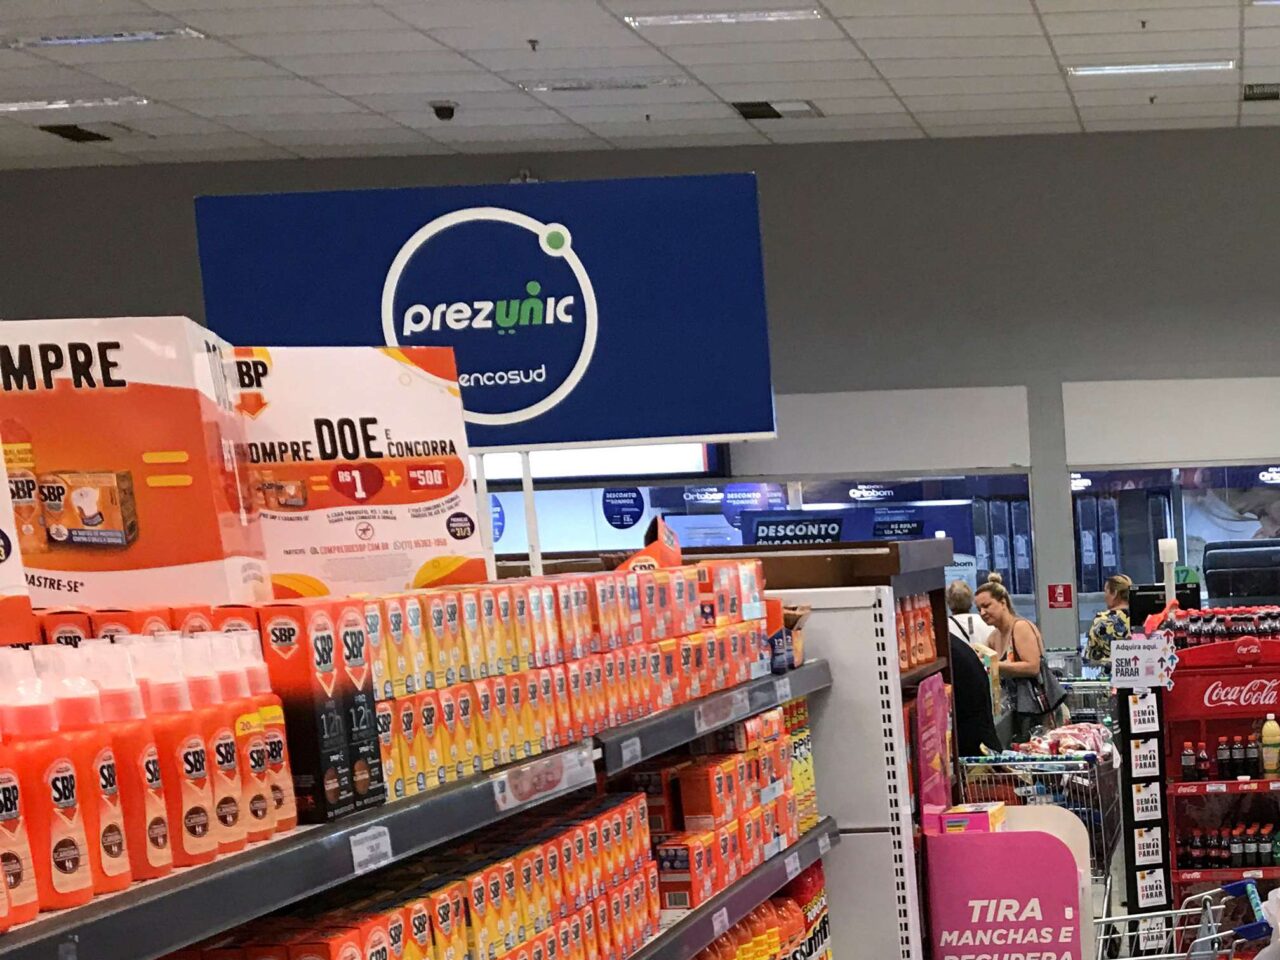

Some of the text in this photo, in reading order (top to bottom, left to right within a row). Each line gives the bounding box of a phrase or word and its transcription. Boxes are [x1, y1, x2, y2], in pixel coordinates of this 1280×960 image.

[403, 281, 574, 336] prezunic
[458, 365, 547, 387] encosud
[314, 417, 384, 461] DOE
[387, 440, 457, 458] CONCORRA
[39, 483, 65, 502] SBP
[351, 470, 366, 499] 1
[758, 523, 840, 538] DESCONTO
[1174, 569, 1189, 583] 17
[271, 627, 296, 643] SBP
[343, 630, 365, 661] SBP
[314, 634, 333, 666] SBP
[1116, 643, 1141, 651] Adquira
[1116, 658, 1131, 667] SEM
[1116, 668, 1139, 677] PARAR
[184, 749, 205, 777] SBP
[52, 776, 76, 809] SBP
[968, 898, 1043, 923] TIRA
[940, 926, 1074, 947] MANCHAS E
